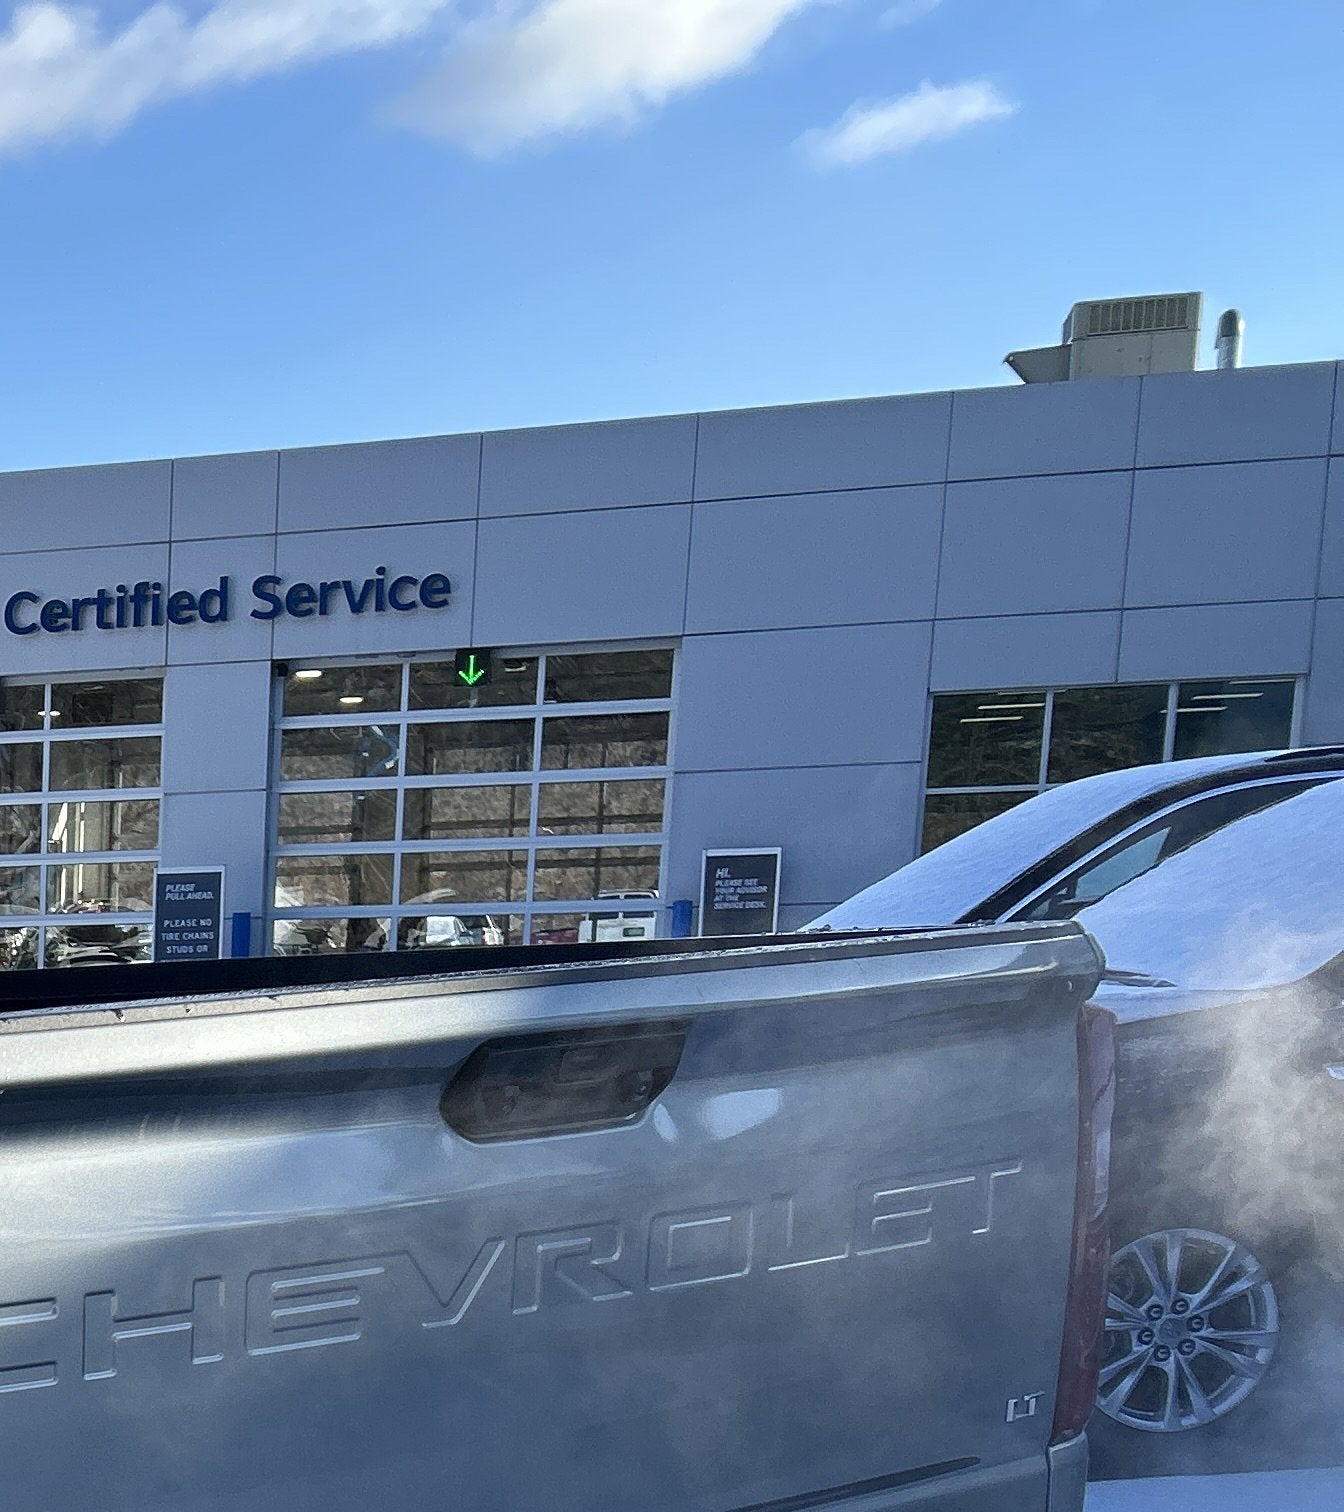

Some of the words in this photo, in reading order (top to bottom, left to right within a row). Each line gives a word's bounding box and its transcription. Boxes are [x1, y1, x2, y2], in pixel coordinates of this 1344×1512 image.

[4, 576, 229, 635] Certified
[250, 566, 452, 620] Service
[165, 884, 196, 892] PLEASE
[165, 892, 185, 901] PULL
[163, 919, 198, 928] PLEASE
[200, 918, 212, 927] NO
[161, 932, 180, 941] TIRE
[182, 931, 214, 940] CHAINS
[166, 945, 194, 954] STUDS
[196, 944, 209, 953] OR
[1005, 1390, 1046, 1423] LT
